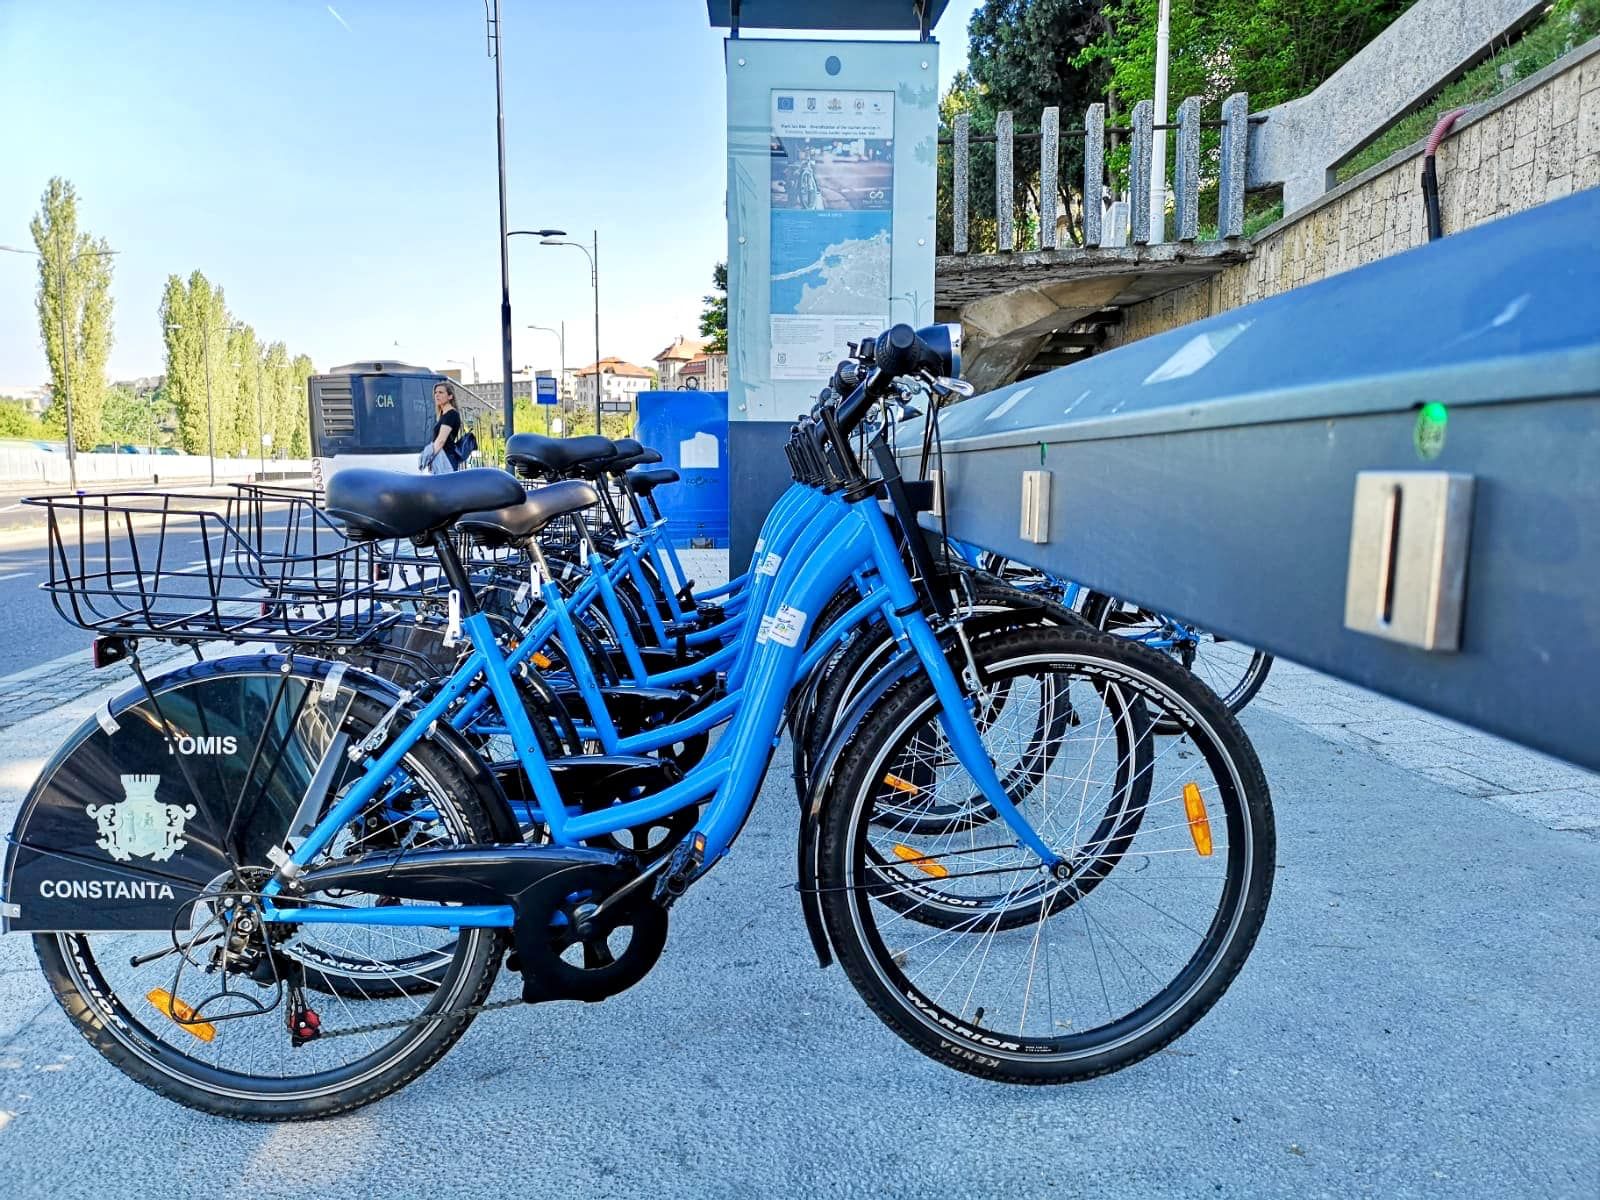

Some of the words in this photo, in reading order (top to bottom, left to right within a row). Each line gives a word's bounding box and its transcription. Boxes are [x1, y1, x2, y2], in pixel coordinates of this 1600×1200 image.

[1081, 665, 1195, 728] WARRIOR
[163, 735, 238, 755] TOMIS
[39, 879, 175, 900] CONSTANTA
[887, 869, 978, 907] WARRIOR
[67, 931, 128, 1030] ARRIOR
[906, 990, 1020, 1051] WARRIOR
[940, 1039, 1000, 1068] KENDA
